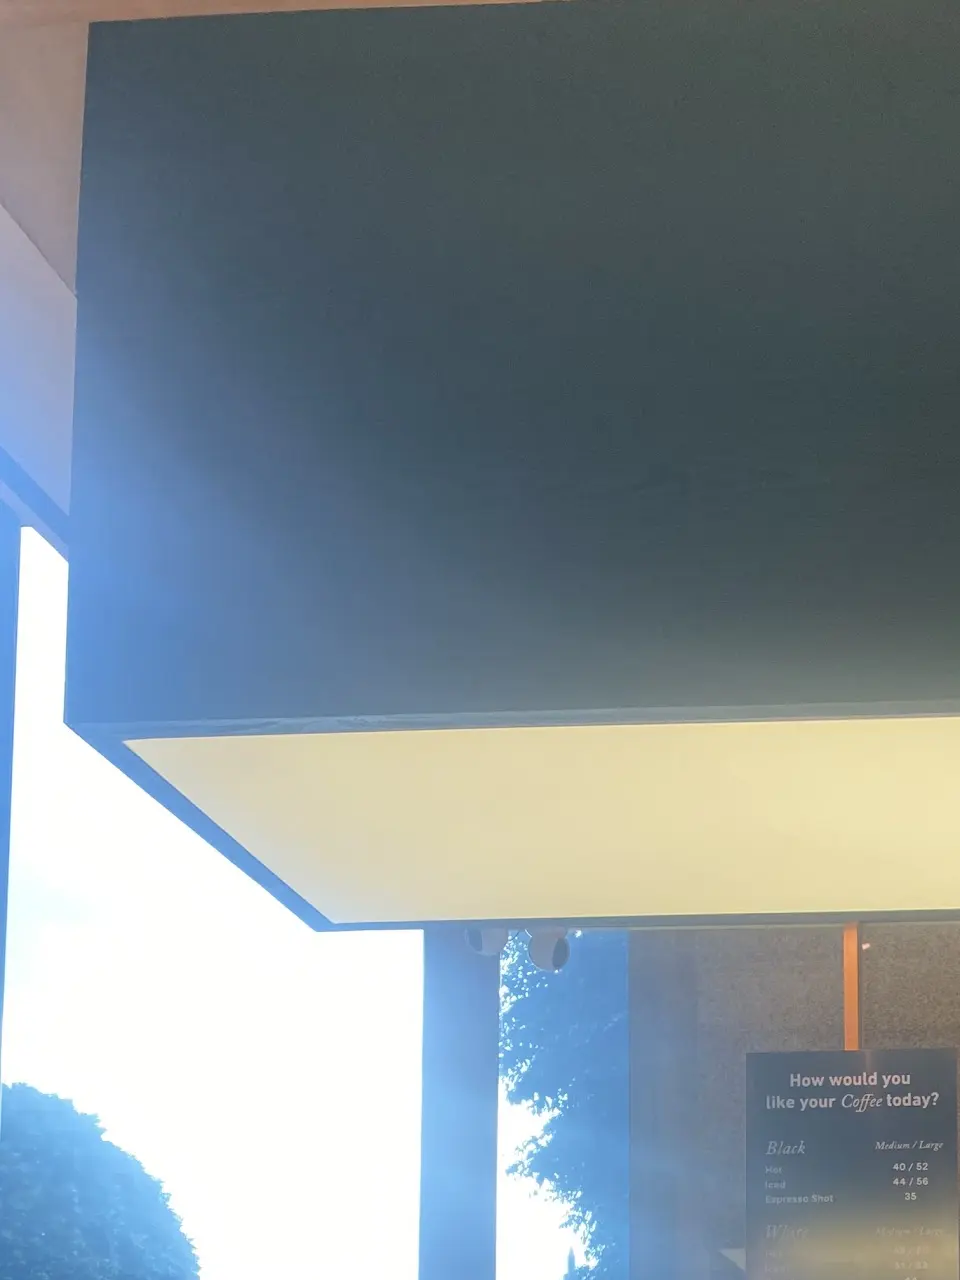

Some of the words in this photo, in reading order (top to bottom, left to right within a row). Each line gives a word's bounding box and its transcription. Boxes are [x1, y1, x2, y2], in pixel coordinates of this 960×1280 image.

[790, 1073, 824, 1087] How
[829, 1072, 877, 1086] would
[882, 1073, 910, 1088] you
[766, 1095, 794, 1109] like
[800, 1096, 835, 1111] your
[841, 1094, 882, 1112] Coffee
[886, 1092, 939, 1108] today?
[766, 1141, 805, 1155] Black
[875, 1141, 909, 1150] Medium
[919, 1141, 943, 1151] Large
[765, 1166, 782, 1174] Hot
[892, 1163, 905, 1171] 40
[892, 1178, 905, 1186] 44
[765, 1196, 809, 1205] Espresso
[812, 1194, 833, 1203] Shot
